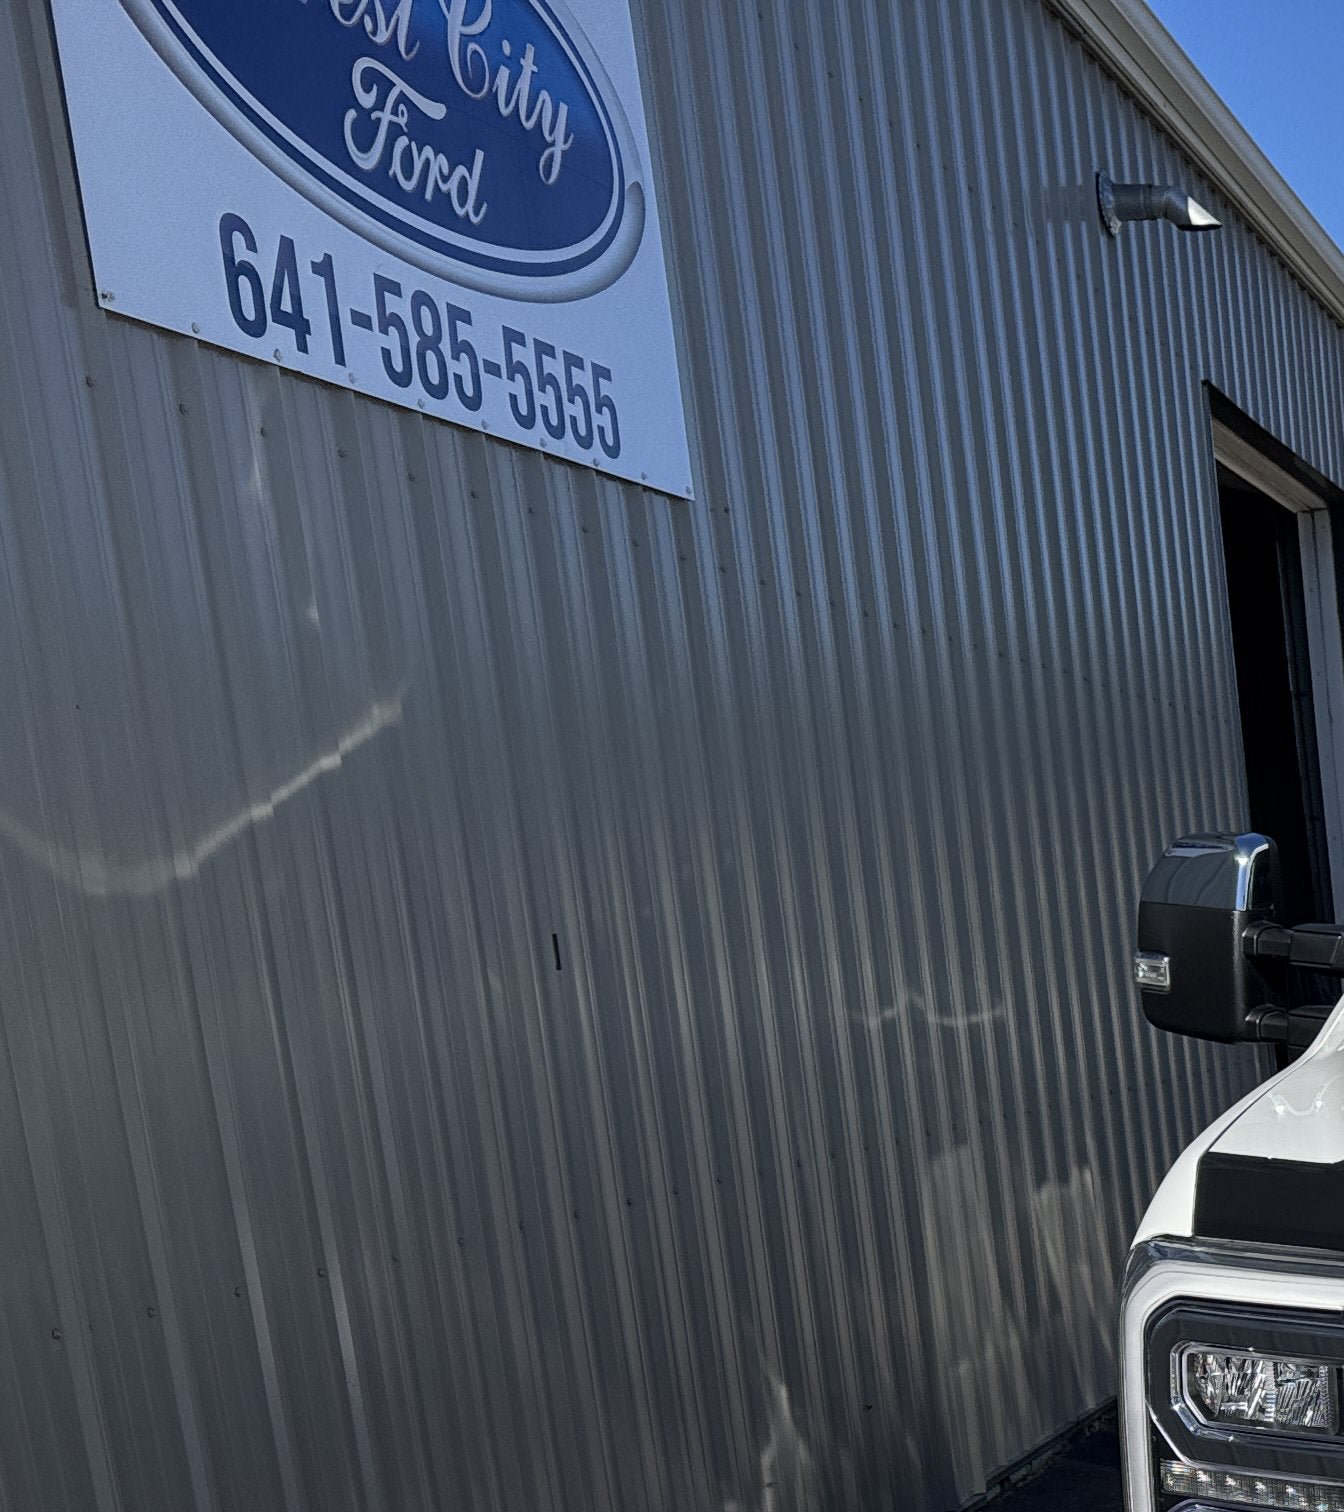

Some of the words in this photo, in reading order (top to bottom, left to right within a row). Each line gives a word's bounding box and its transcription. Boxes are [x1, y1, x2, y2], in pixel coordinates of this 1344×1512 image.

[343, 56, 488, 225] Ford
[438, 0, 575, 185] City
[219, 212, 622, 460] 641-585-5555
